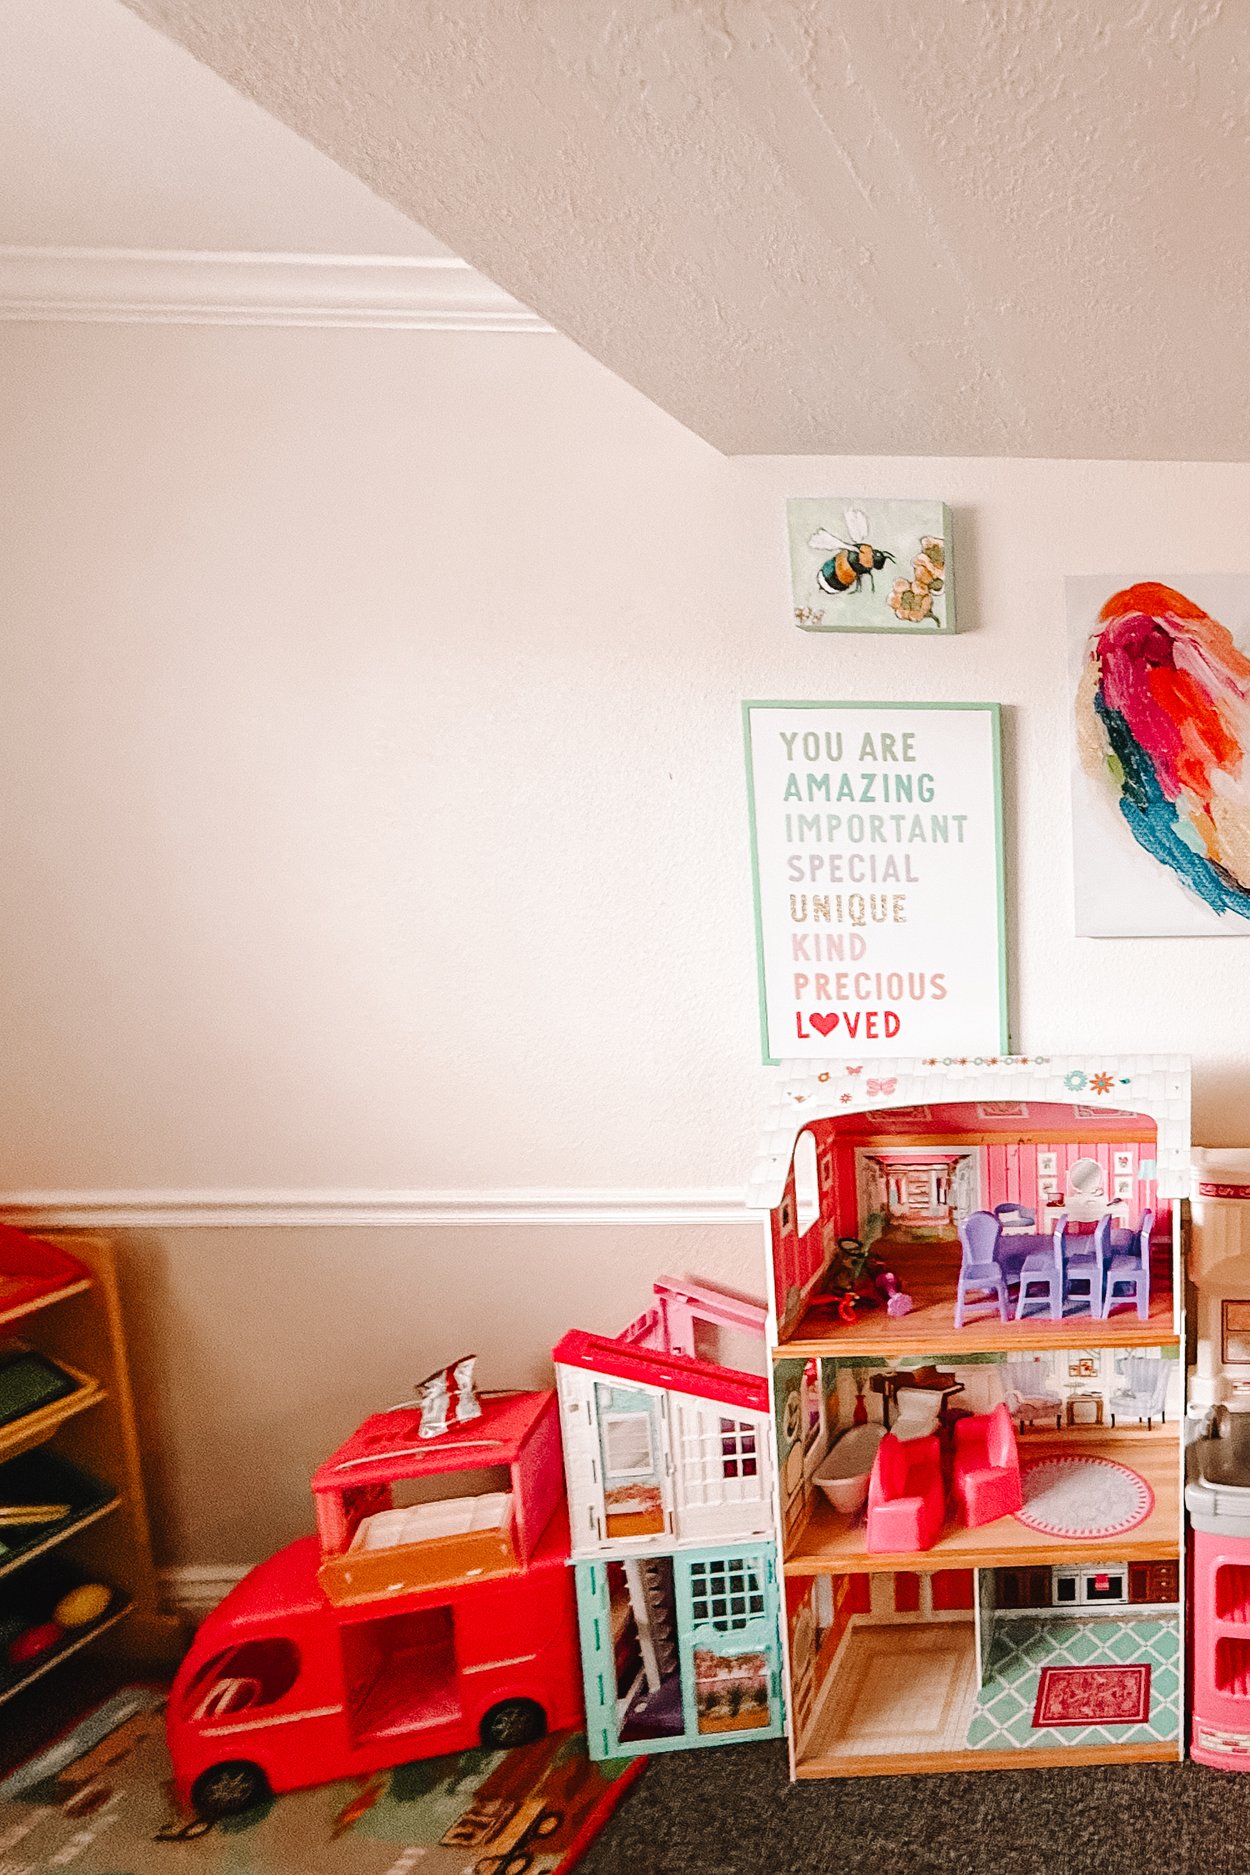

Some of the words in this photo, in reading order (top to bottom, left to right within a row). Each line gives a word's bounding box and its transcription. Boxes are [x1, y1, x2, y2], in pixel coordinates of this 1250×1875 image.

[780, 732, 844, 762] YOU
[858, 732, 917, 762] ARE
[783, 773, 936, 803] AMAZING
[785, 814, 968, 844] IMPORTANT
[787, 854, 920, 883] SPECIAL
[789, 893, 907, 927] UNIQUE
[791, 933, 867, 962] KIND
[793, 972, 948, 1001] PRECIOUS
